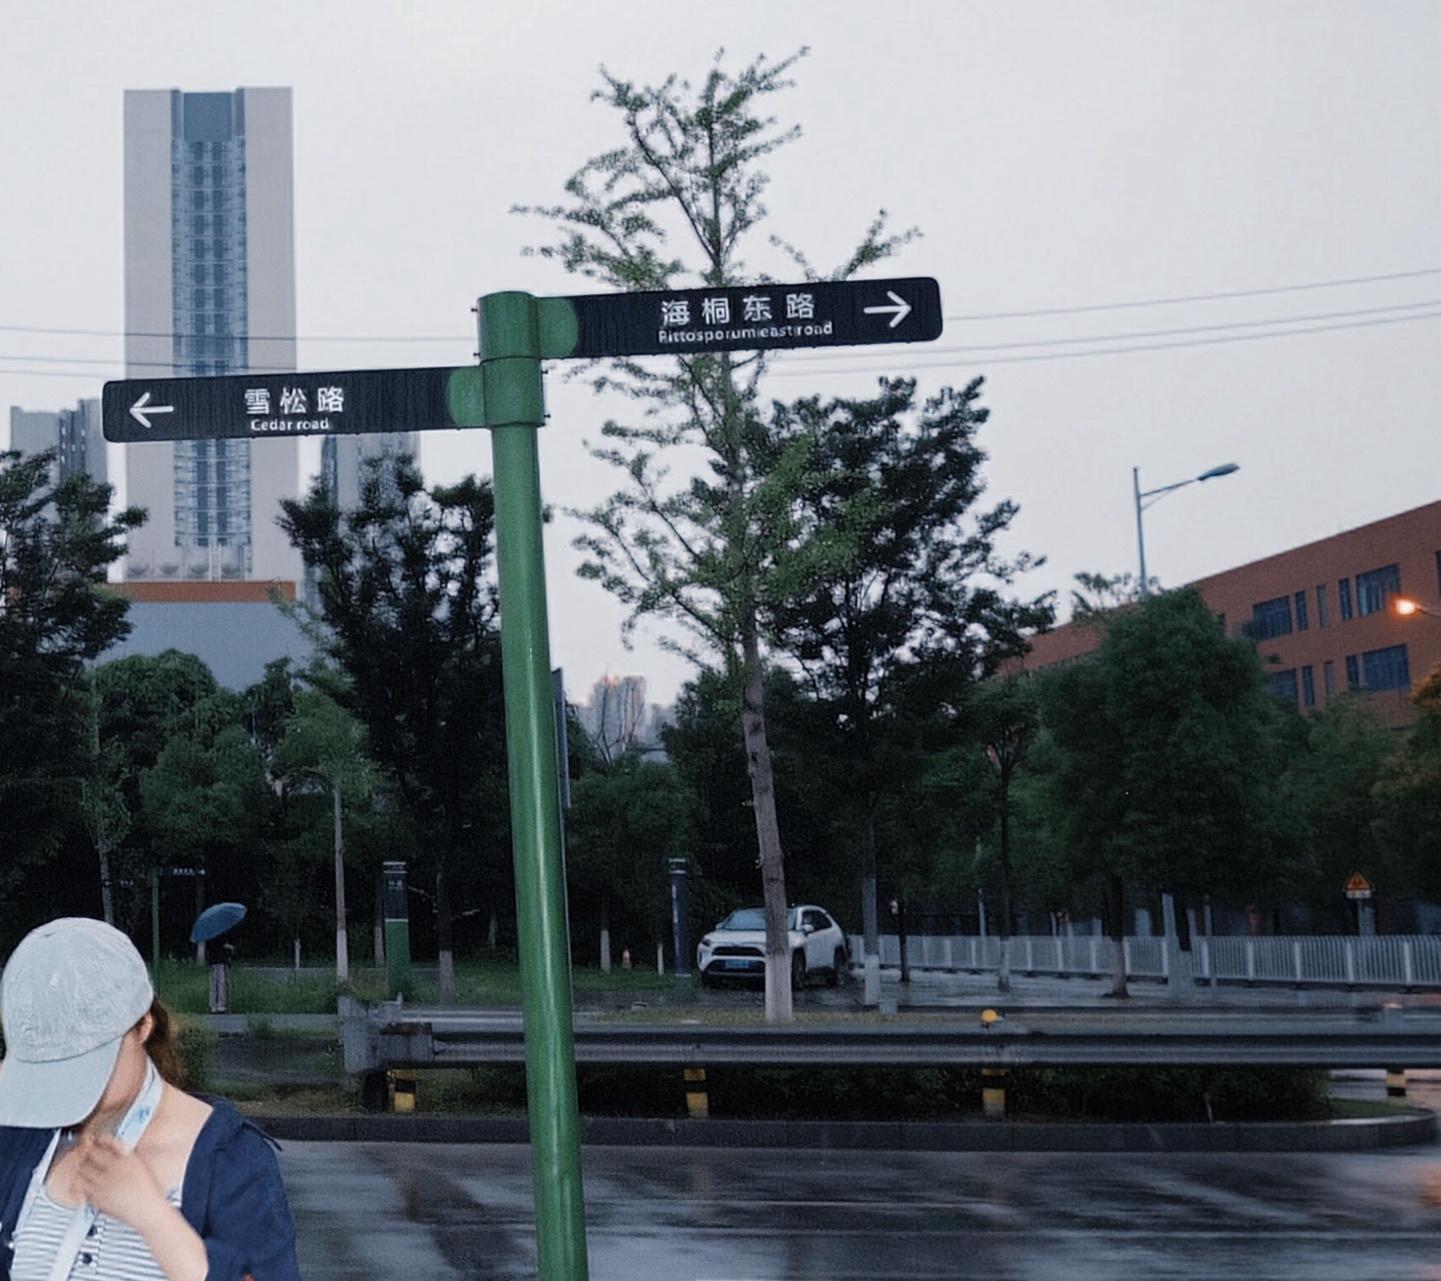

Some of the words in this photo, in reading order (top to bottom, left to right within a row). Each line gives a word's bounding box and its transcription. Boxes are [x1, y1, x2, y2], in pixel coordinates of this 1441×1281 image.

[661, 292, 815, 327] 海桐东路
[796, 321, 833, 336] road
[244, 386, 345, 415] 雪松路
[250, 418, 293, 431] Cedar
[296, 417, 329, 430] road
